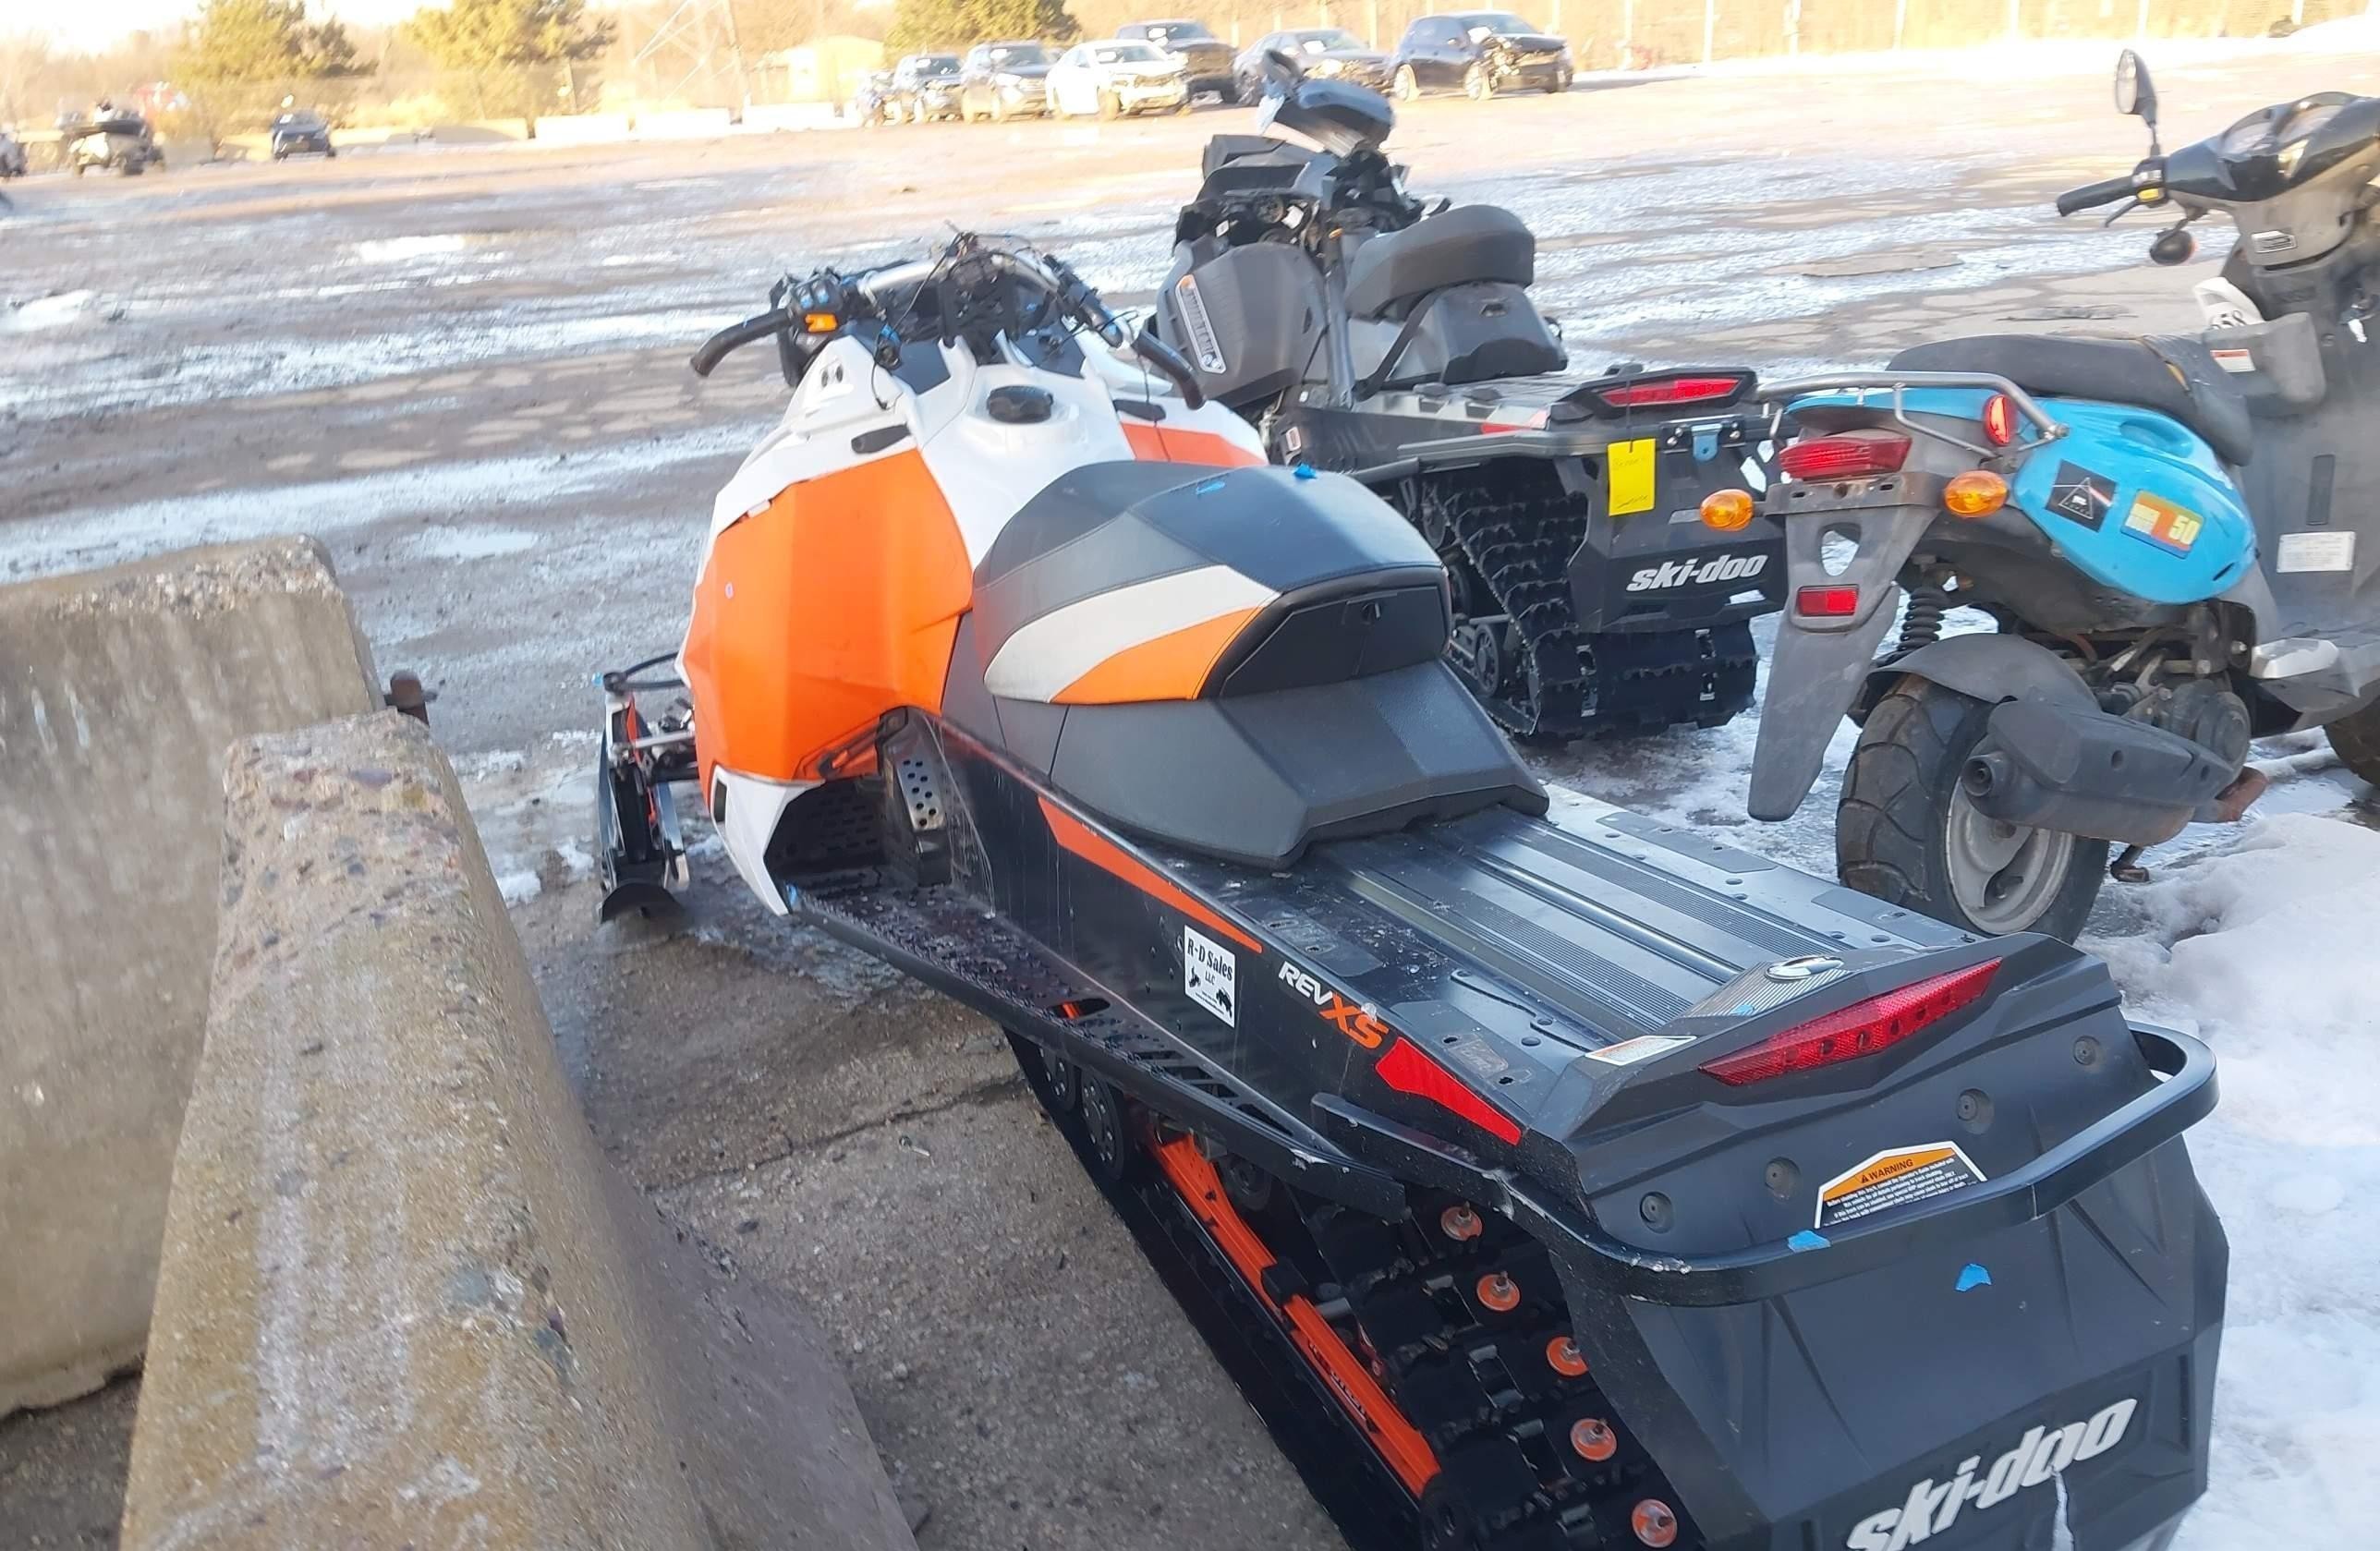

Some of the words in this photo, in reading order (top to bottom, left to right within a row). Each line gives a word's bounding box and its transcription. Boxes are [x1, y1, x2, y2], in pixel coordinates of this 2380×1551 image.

[1626, 554, 1768, 592] ski-doo
[1187, 937, 1206, 963] R-D
[1207, 951, 1232, 981] Sales
[1205, 971, 1216, 986] LLC
[1868, 1158, 1913, 1181] WARNING
[1846, 1398, 2138, 1551] ski-doo
